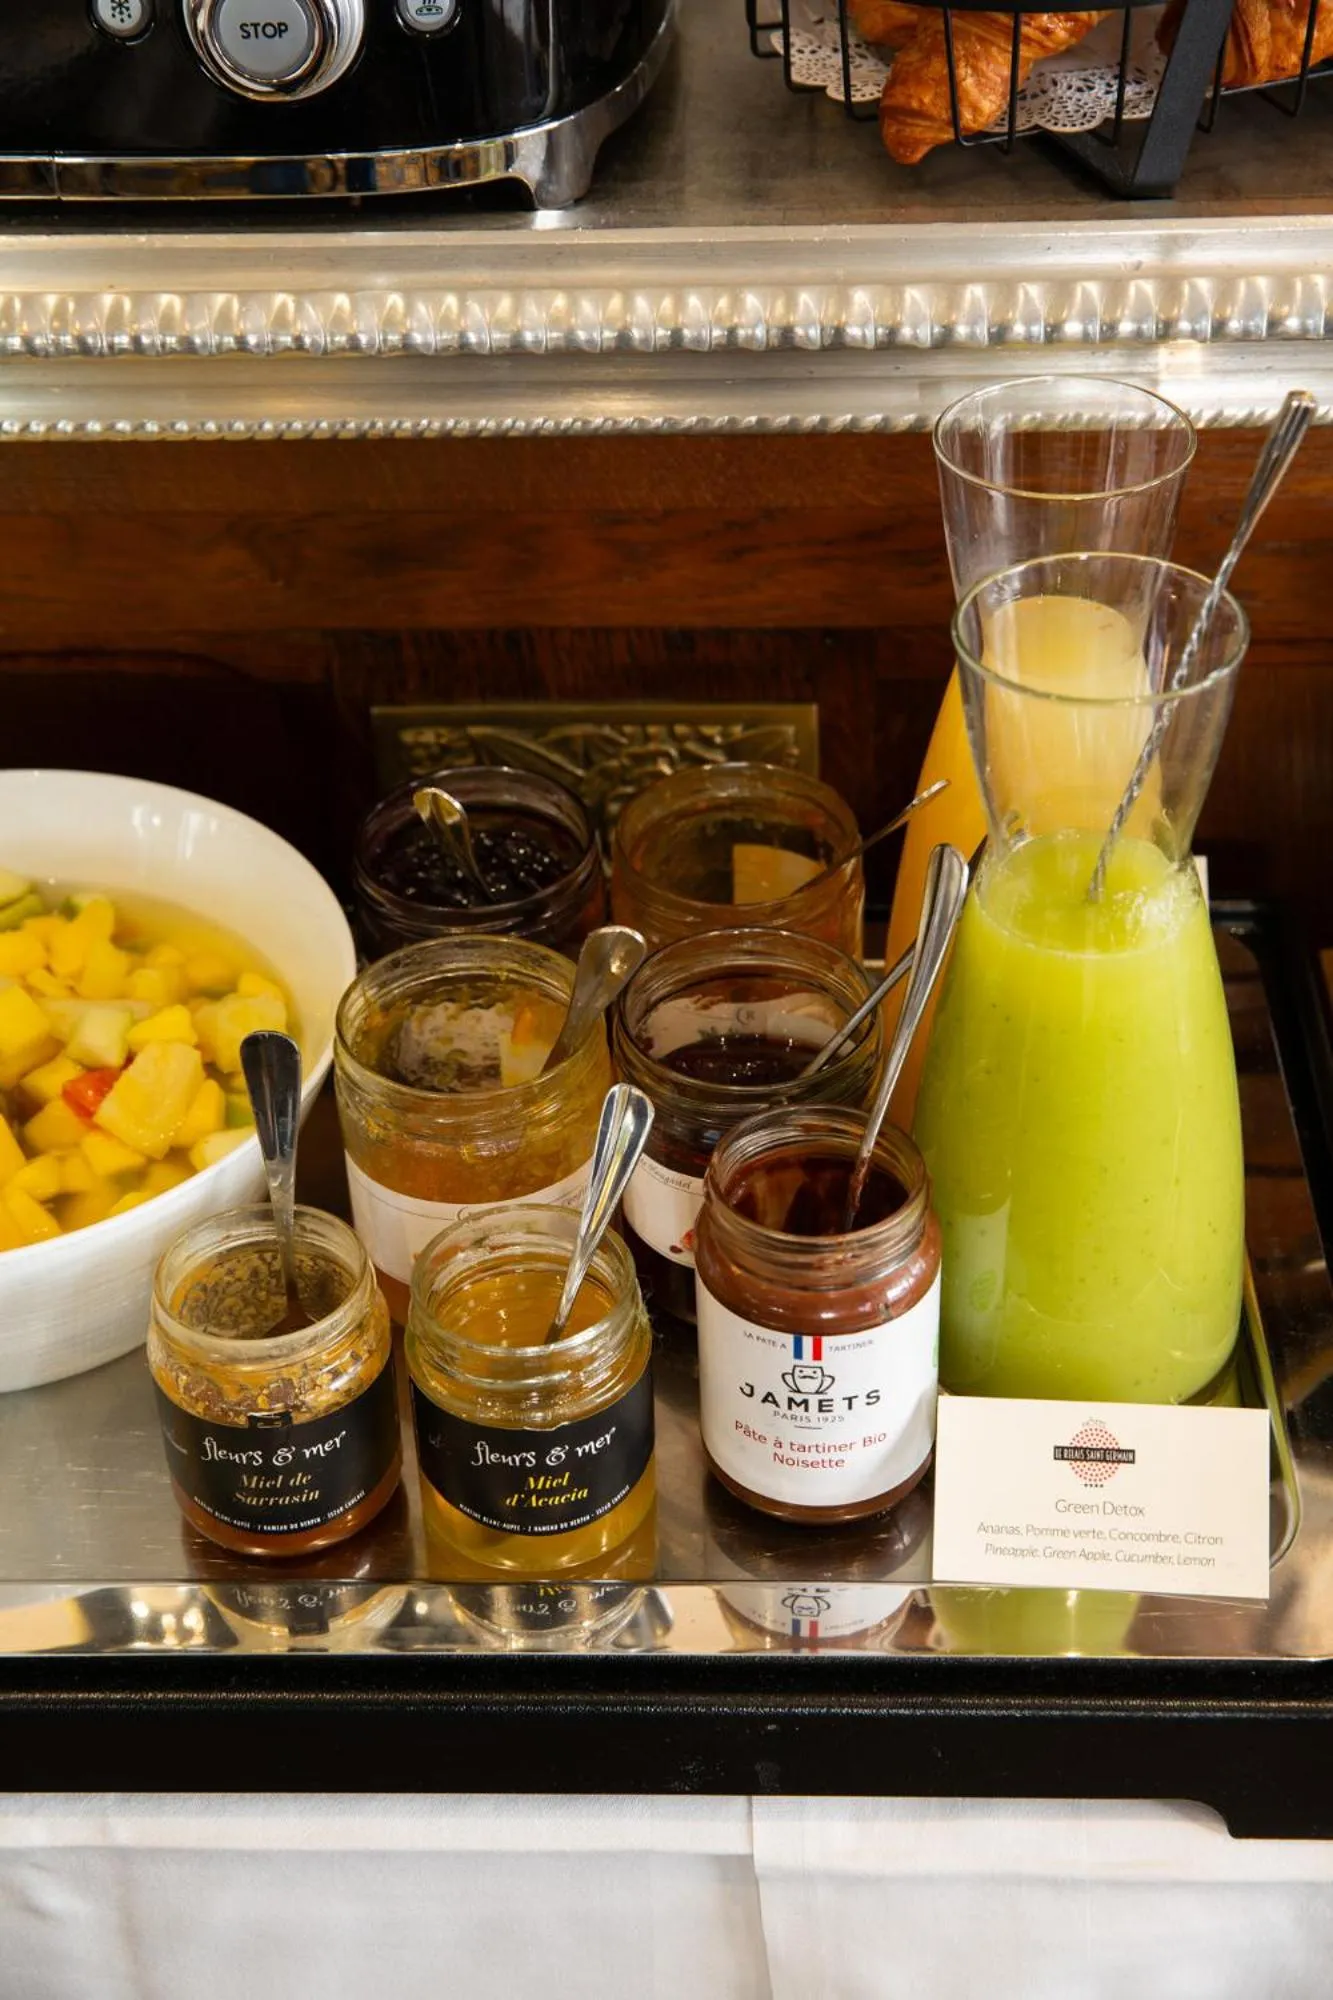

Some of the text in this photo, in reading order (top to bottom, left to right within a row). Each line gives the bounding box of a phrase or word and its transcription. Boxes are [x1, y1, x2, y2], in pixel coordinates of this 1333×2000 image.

[239, 22, 289, 40] STOP
[828, 1339, 874, 1353] TARTINER
[739, 1382, 881, 1413] JAMETS
[772, 1410, 845, 1424] PARIS 1925
[735, 1420, 887, 1454] Pâte à tartiner Bio
[201, 1430, 347, 1467] fleurs & mer
[471, 1440, 536, 1468] fleurs
[545, 1445, 569, 1467] &
[575, 1426, 617, 1458] mer
[1085, 1448, 1105, 1461] SAINT
[1105, 1449, 1134, 1463] GERMAIN
[772, 1452, 845, 1469] Noisette
[240, 1472, 312, 1490] Miel de
[525, 1472, 571, 1491] Miel
[232, 1489, 320, 1507] Sarrasin
[505, 1487, 589, 1508] d'Acacia
[1055, 1499, 1146, 1517] Green Detox
[977, 1521, 1224, 1546] Ananas, Pomme verte, Concombre, Citron
[1043, 1546, 1077, 1559] Green
[1177, 1553, 1216, 1568] Lemon
